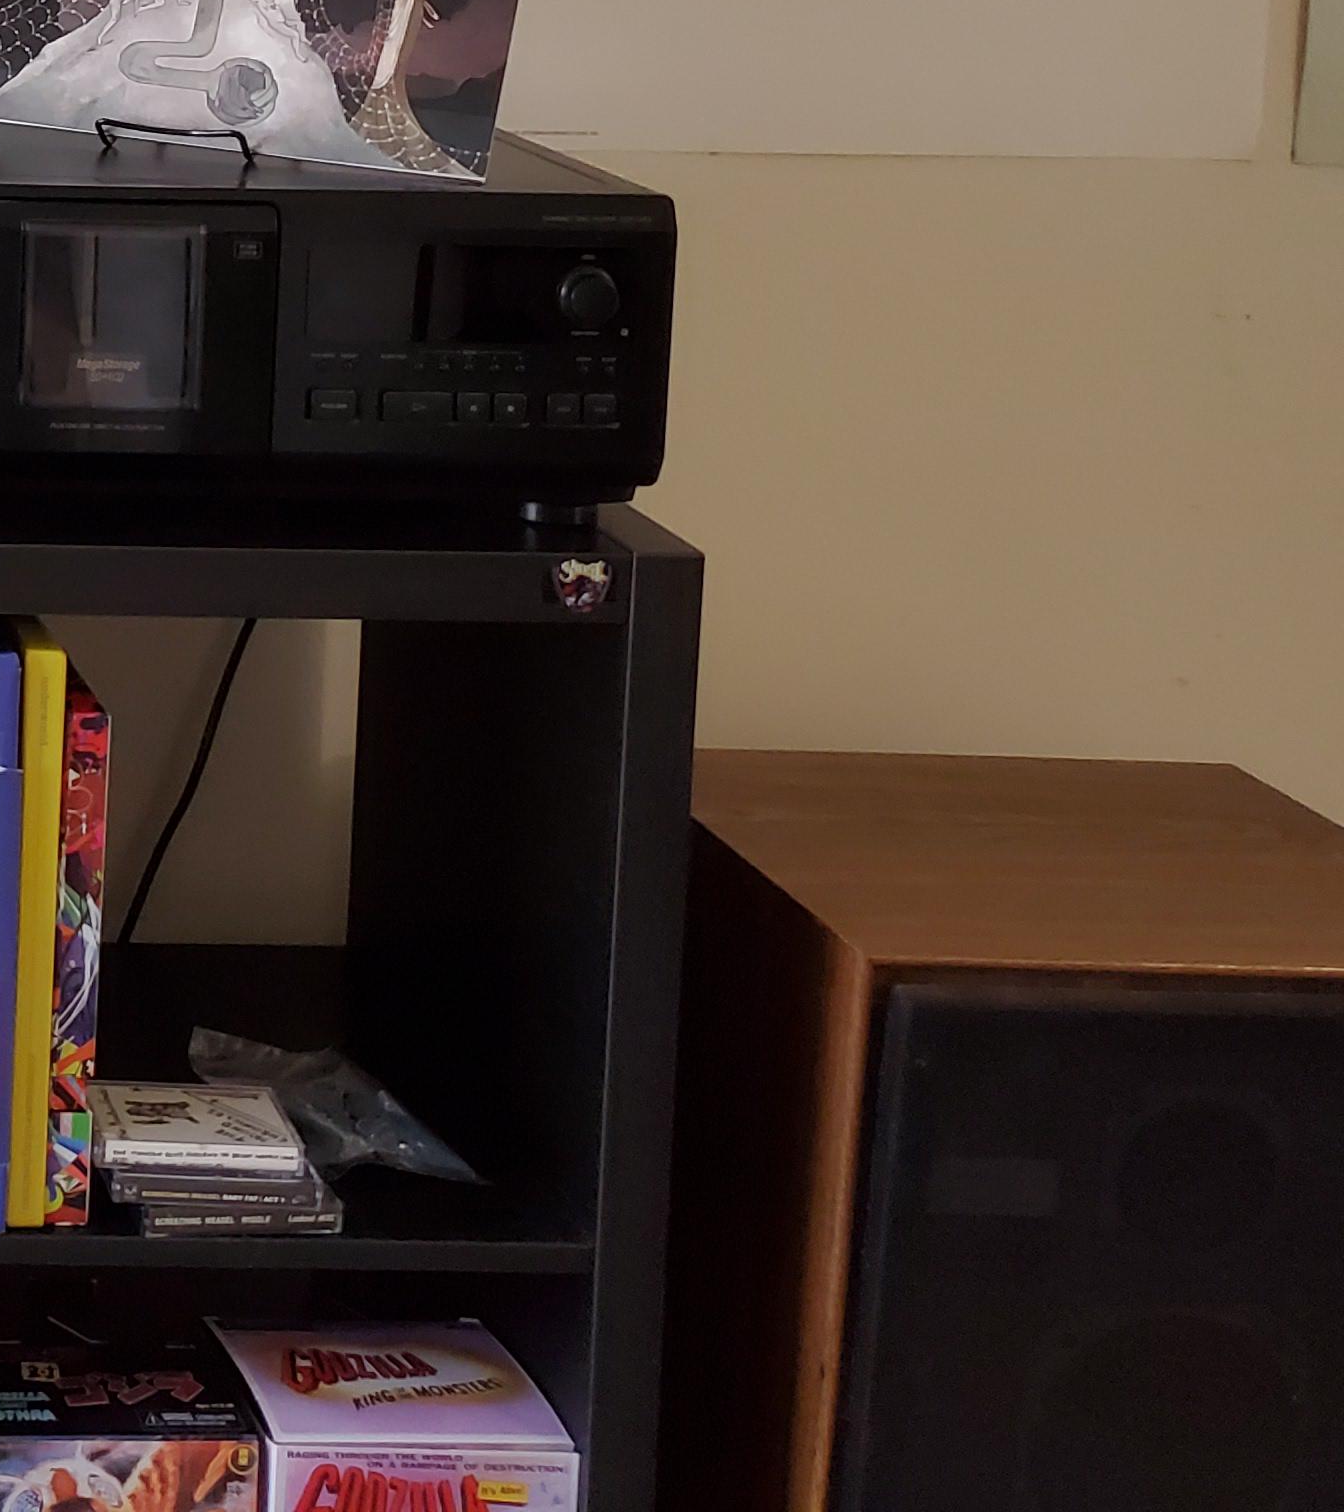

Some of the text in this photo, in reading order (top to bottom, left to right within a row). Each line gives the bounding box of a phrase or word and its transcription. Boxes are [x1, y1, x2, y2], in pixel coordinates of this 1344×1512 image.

[280, 1347, 440, 1395] GODZILLA
[353, 1392, 397, 1411] KING
[410, 1378, 505, 1399] MONSTERS
[394, 1452, 418, 1461] THE
